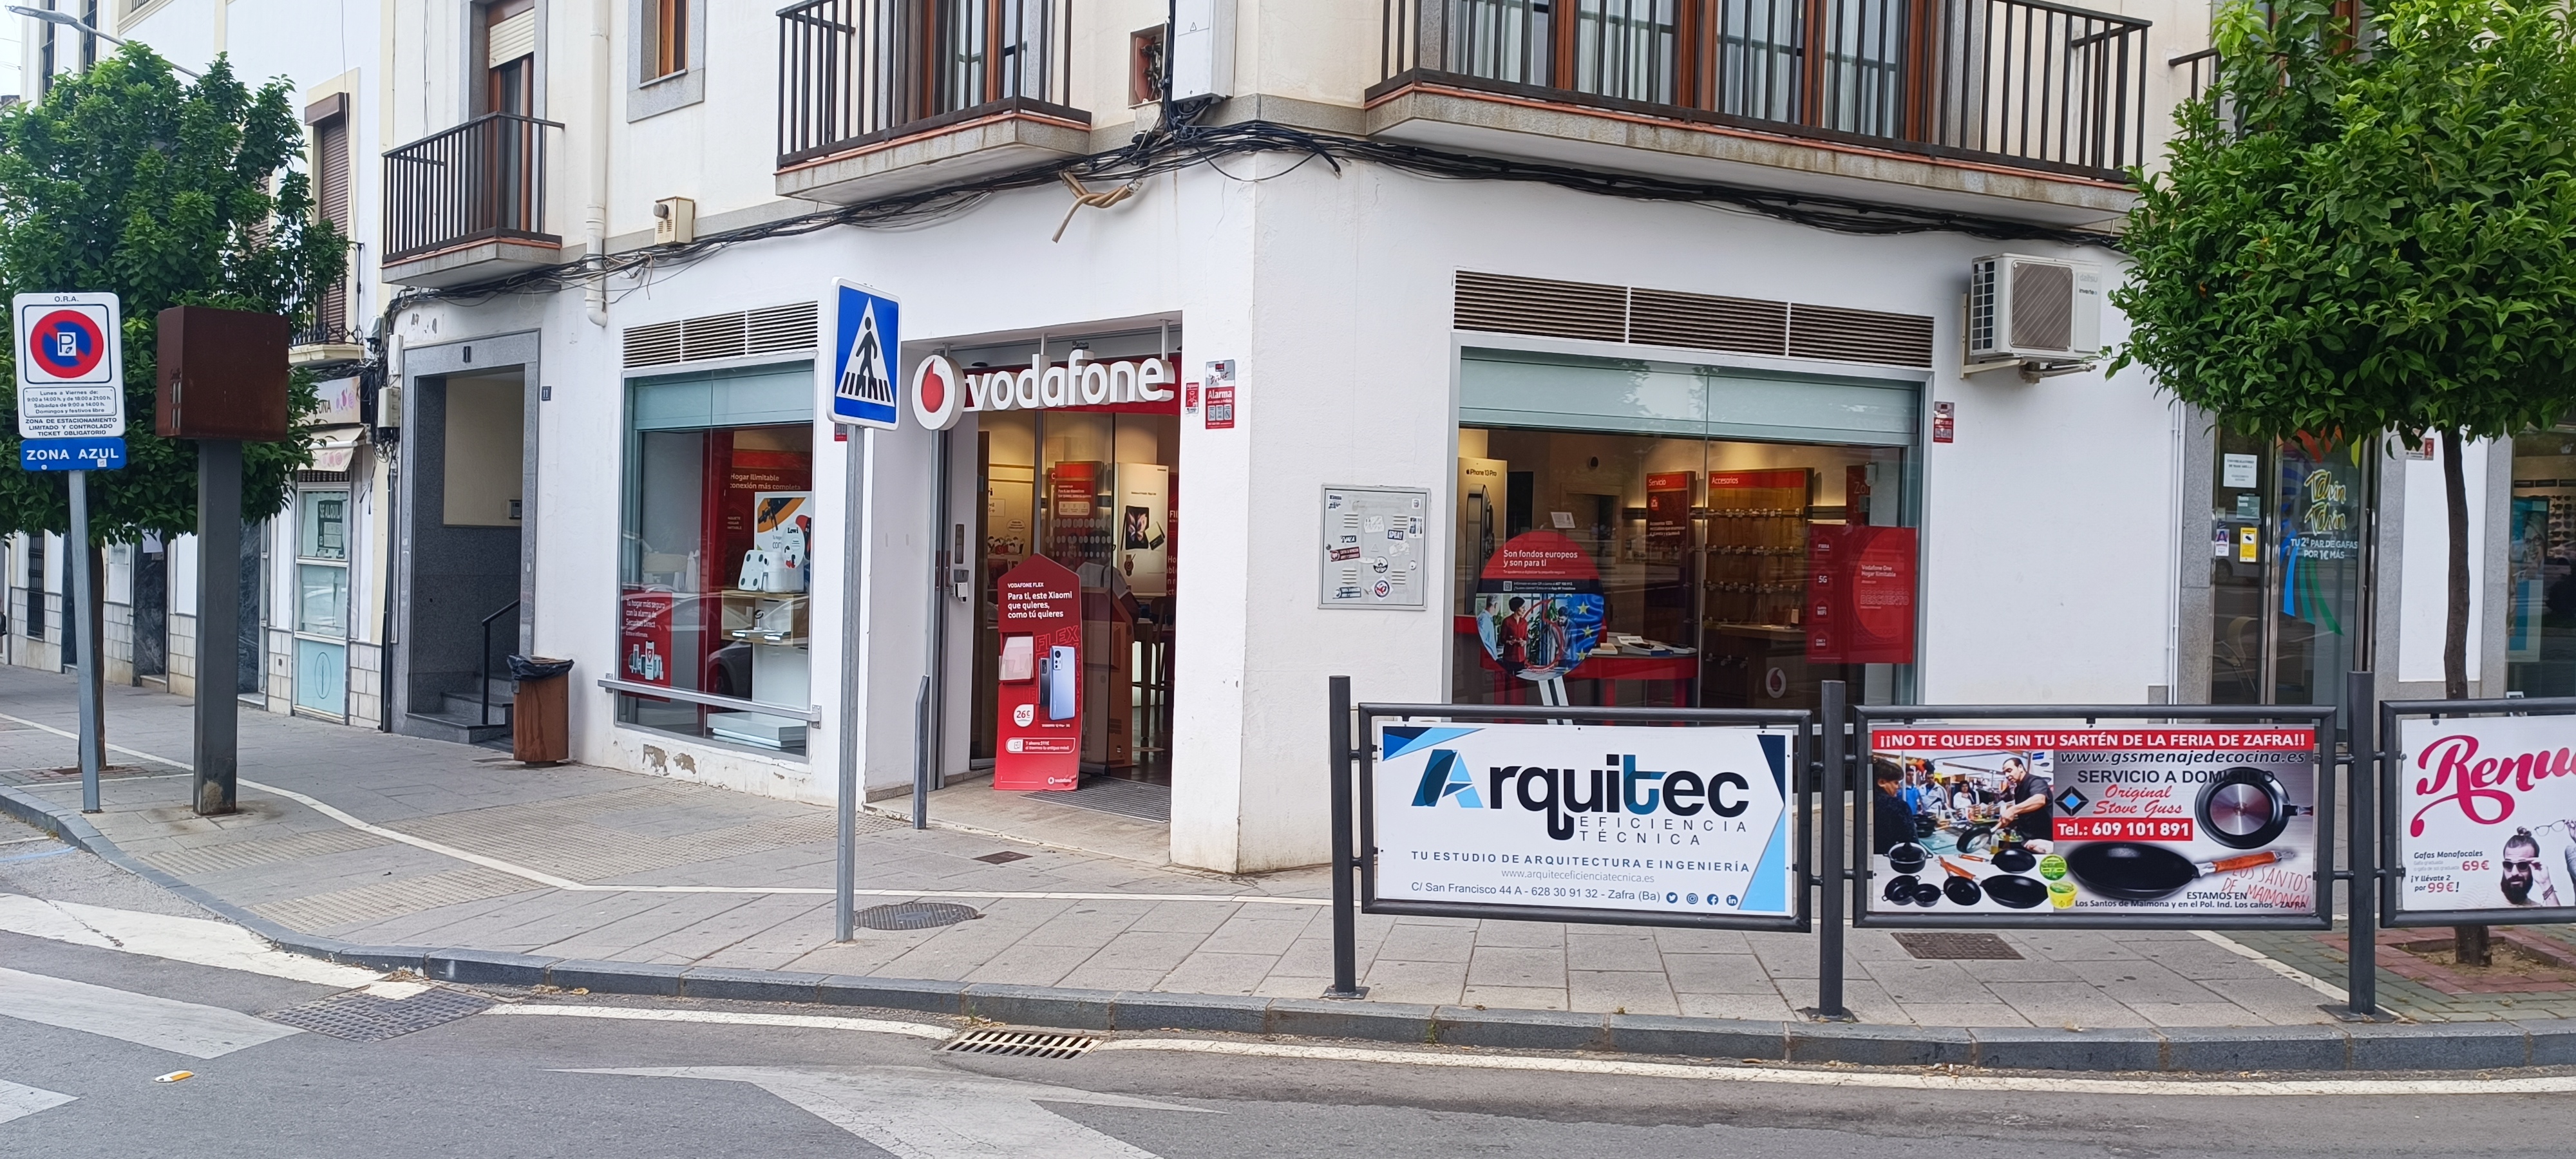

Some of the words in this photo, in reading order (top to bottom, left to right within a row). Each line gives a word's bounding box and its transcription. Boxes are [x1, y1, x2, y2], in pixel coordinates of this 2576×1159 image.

[967, 349, 1175, 411] vodafone
[1208, 390, 1233, 399] Alarma
[26, 449, 70, 460] ZONA
[78, 448, 119, 459] AZUL
[730, 473, 750, 482] Hogar
[2291, 538, 2300, 547] TU
[2310, 539, 2324, 547] PAR
[2335, 540, 2358, 549] GAFAS
[1503, 549, 1517, 558] Son
[1519, 549, 1544, 558] fondos
[1545, 551, 1578, 560] europeos
[2329, 549, 2345, 558] MÁS
[631, 599, 642, 608] hogar
[1860, 594, 1909, 605] DESCUENTO
[1008, 603, 1021, 611] que
[1037, 610, 1064, 619] quieres
[1035, 625, 1079, 652] FLEX
[1880, 734, 1915, 748] ¡¡NO
[1918, 734, 1937, 746] TE
[1940, 734, 2002, 748] QUEDES
[2005, 734, 2029, 746] SIN
[2034, 734, 2055, 746] TU
[2059, 731, 2118, 746] SARTÉN
[2123, 734, 2143, 746] DE
[2146, 734, 2166, 746] LA
[2170, 734, 2215, 746] FERIA
[2219, 734, 2240, 746] DE
[2246, 733, 2305, 746] ZAFRA!!
[2061, 750, 2306, 765] www.gssmenajedecocina.es
[2077, 770, 2159, 783] SERVICIO
[2164, 771, 2177, 783] A
[2410, 735, 2576, 837] Renu
[1411, 749, 1749, 840] Arquitec
[2105, 784, 2173, 803] Original
[2092, 800, 2138, 815] Stove
[2143, 800, 2183, 818] Guss
[1580, 816, 1746, 833] EFICIENCIA
[2058, 823, 2088, 836] Tel.:
[2092, 822, 2122, 836] 609
[2126, 822, 2155, 836] 101
[2160, 822, 2189, 836] 891
[1580, 829, 1700, 845] TÉCNICA
[1411, 851, 1428, 860] TU
[1434, 852, 1496, 862] ESTUDIO
[1502, 854, 1519, 863] DE
[1524, 855, 1641, 868] ARQUITECTURA
[1647, 860, 1654, 869] E
[1660, 860, 1749, 872] INGENIERÍA
[2414, 851, 2435, 860] Gafas
[2437, 850, 2483, 858] Monofocales
[1501, 870, 1655, 883] www.arquiteceficienciatecnica.es
[2259, 865, 2311, 893] SANTOS
[1411, 881, 1423, 891] C/
[1425, 882, 1445, 892] San
[1448, 883, 1497, 894] Francisco
[1499, 886, 1511, 895] 44
[1514, 886, 1522, 895] A
[1531, 887, 1551, 896] 628
[1553, 887, 1566, 897] 30
[1569, 888, 1581, 897] 91
[1585, 889, 1598, 898] 32
[1607, 889, 1635, 900] Zafra
[1638, 891, 1660, 903] (Ba)
[2221, 878, 2238, 894] DE
